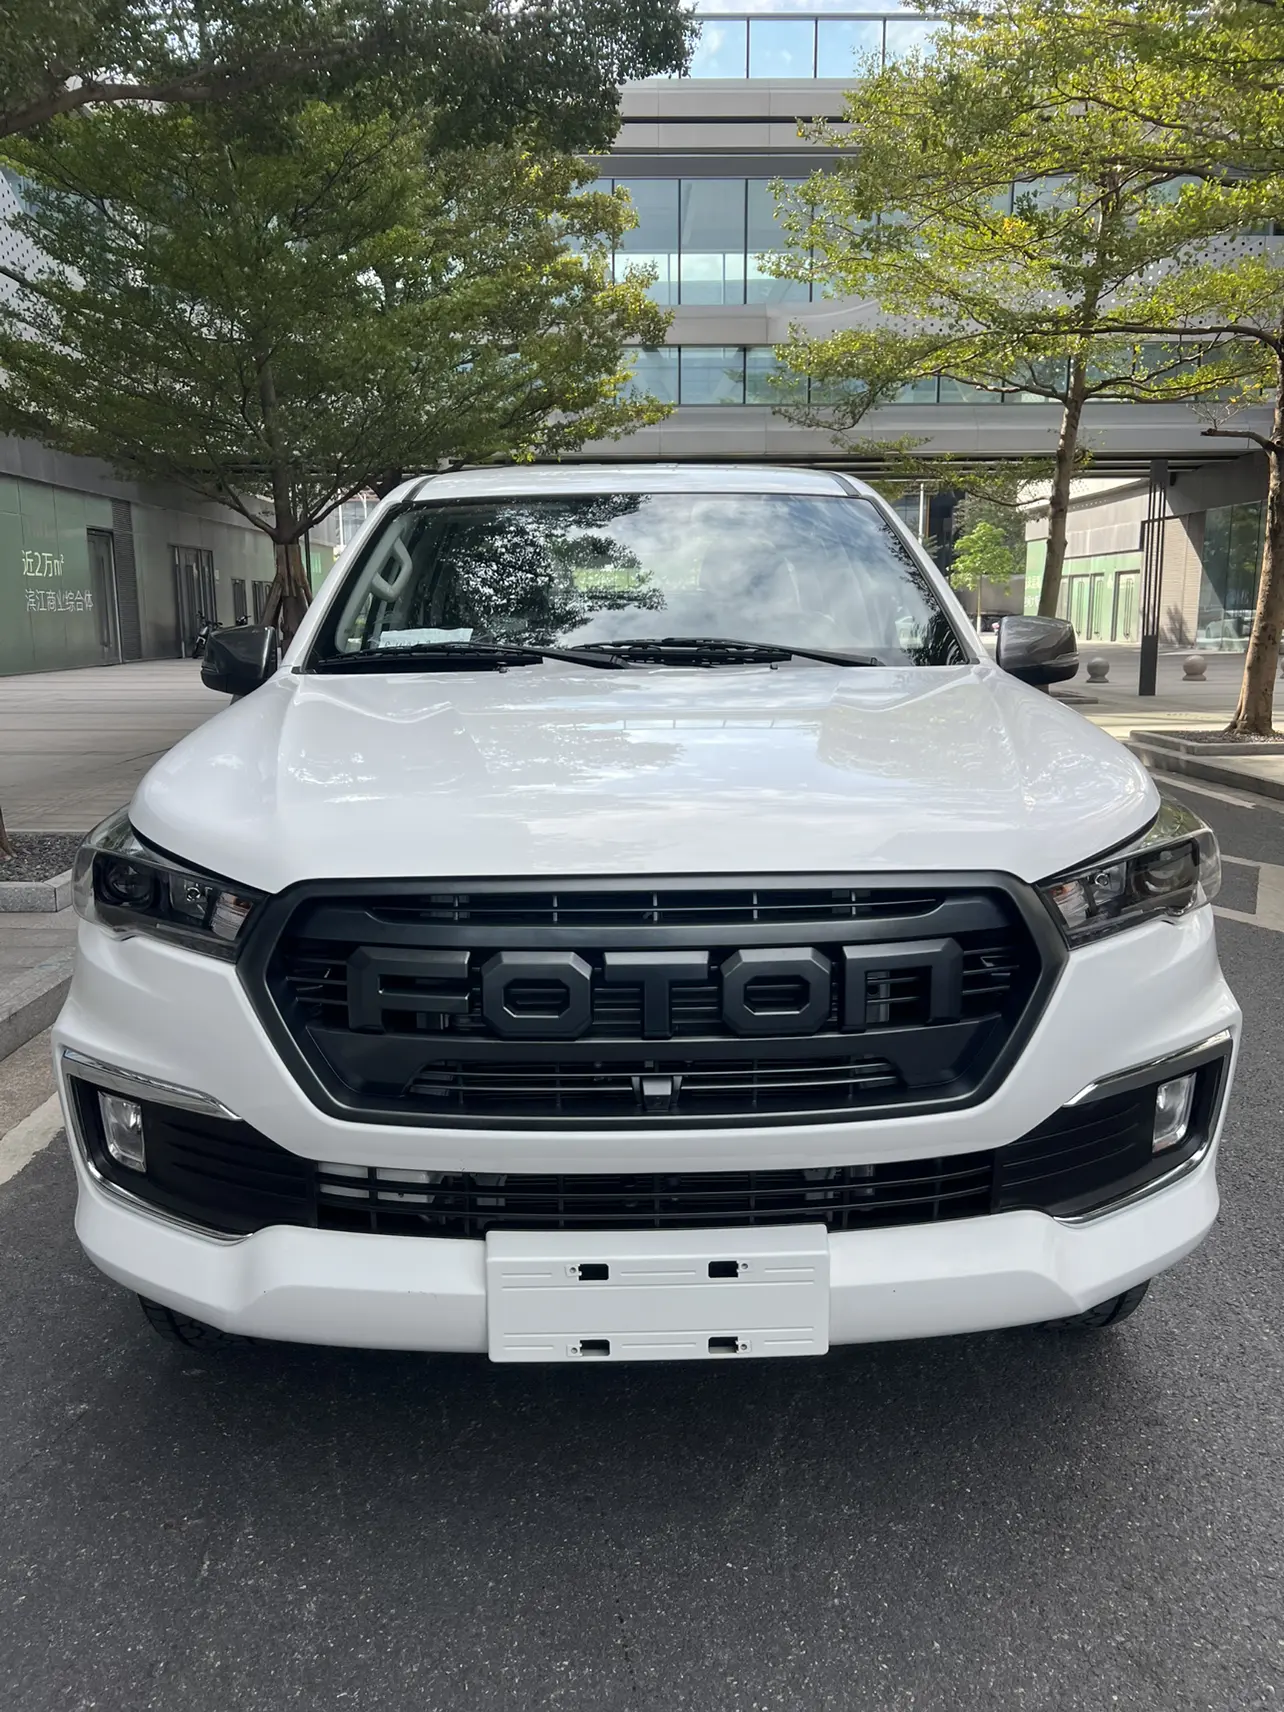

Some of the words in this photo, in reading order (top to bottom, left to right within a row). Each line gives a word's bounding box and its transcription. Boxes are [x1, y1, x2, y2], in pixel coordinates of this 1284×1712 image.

[25, 588, 94, 612] 滨江商业综合体
